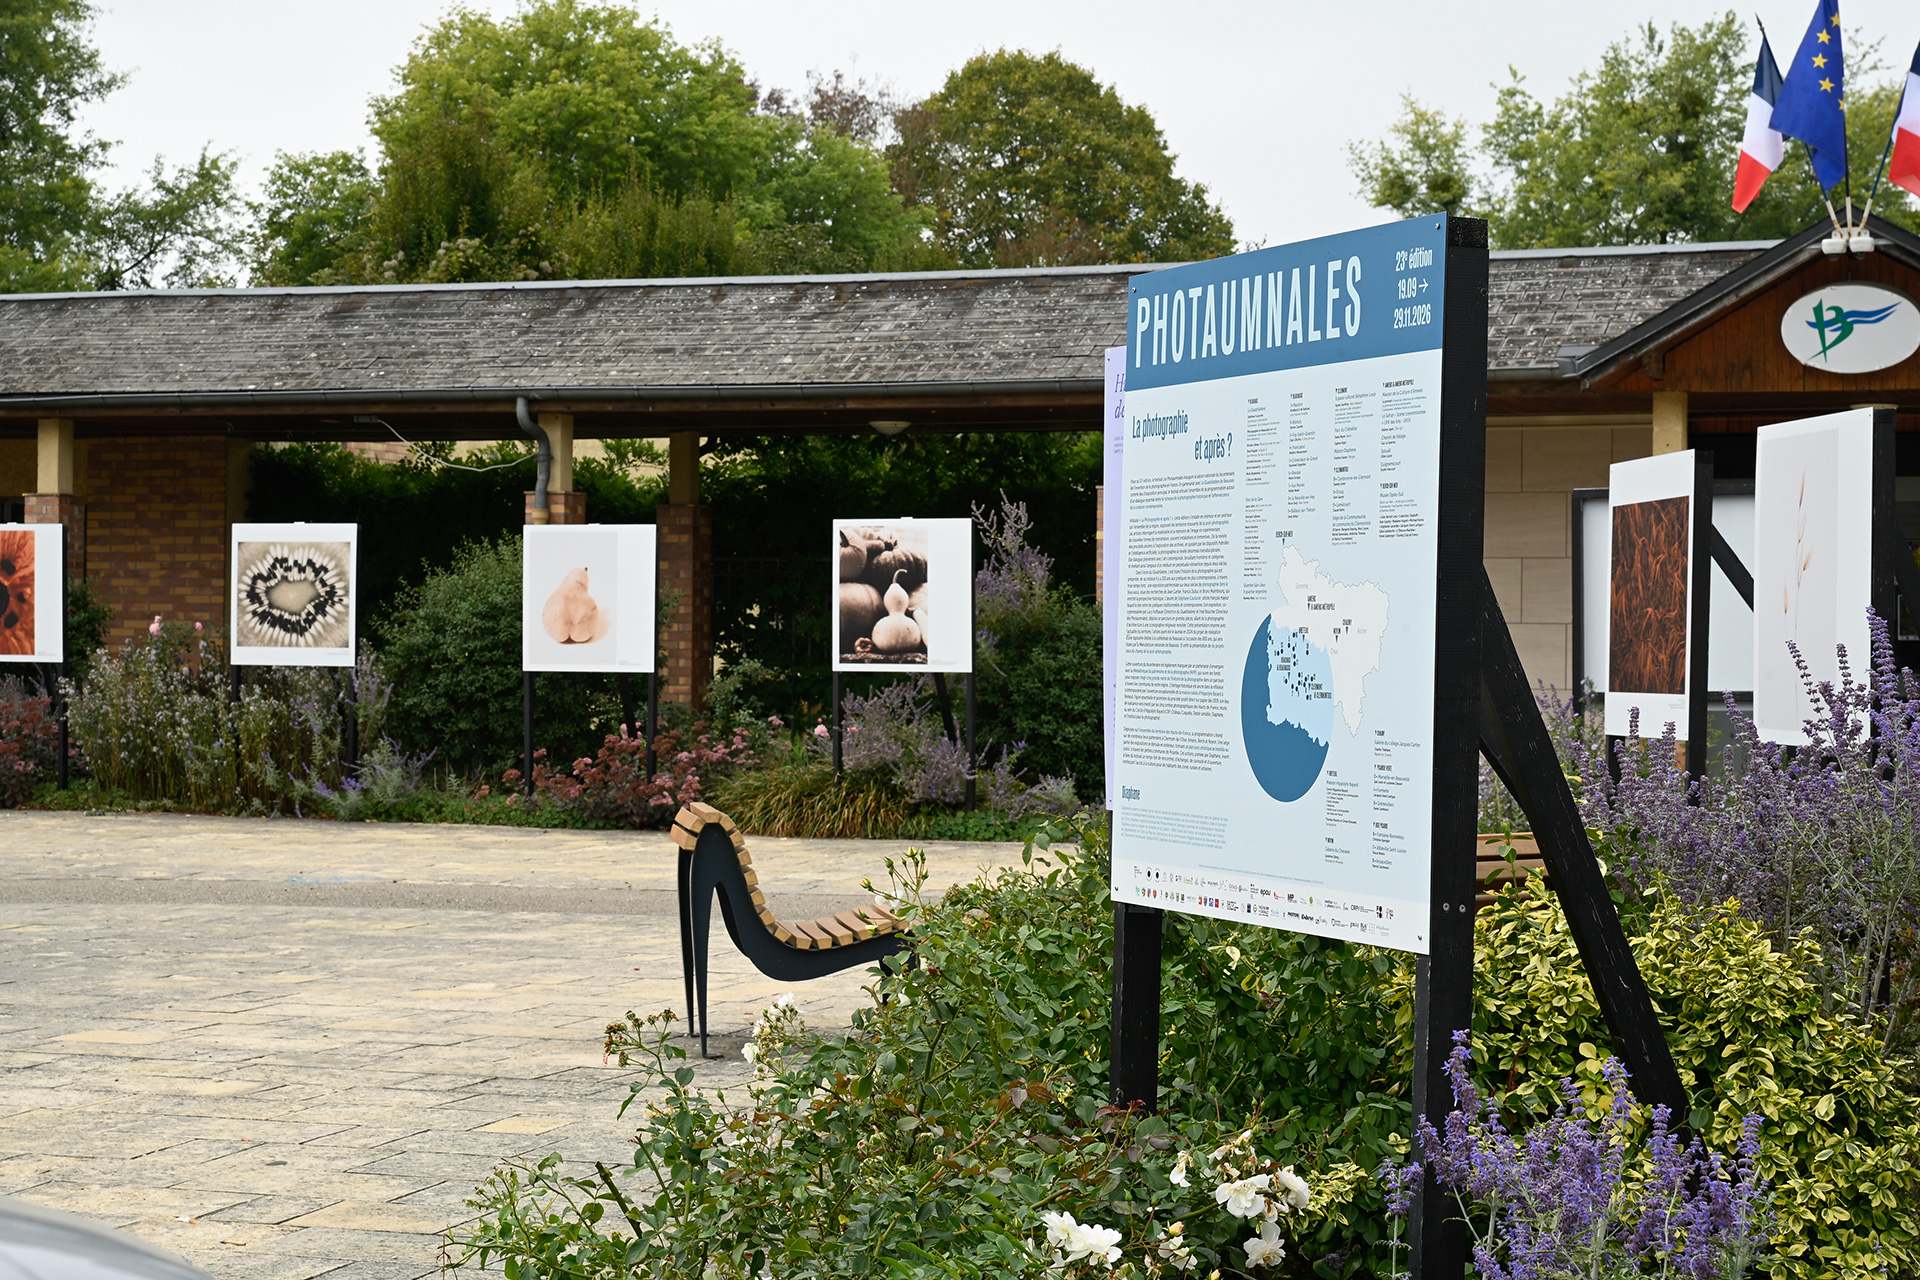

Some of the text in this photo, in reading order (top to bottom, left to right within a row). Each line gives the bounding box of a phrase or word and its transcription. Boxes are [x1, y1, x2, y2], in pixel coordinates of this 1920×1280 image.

[1408, 246, 1433, 270] édition
[1398, 276, 1417, 300] 19.09
[1135, 255, 1362, 369] PHOTAUMNALES
[1394, 304, 1432, 329] 29.11.2026
[1132, 409, 1188, 442] La photographie
[1194, 432, 1233, 464] et après ?
[1122, 785, 1140, 802] Diaphane
